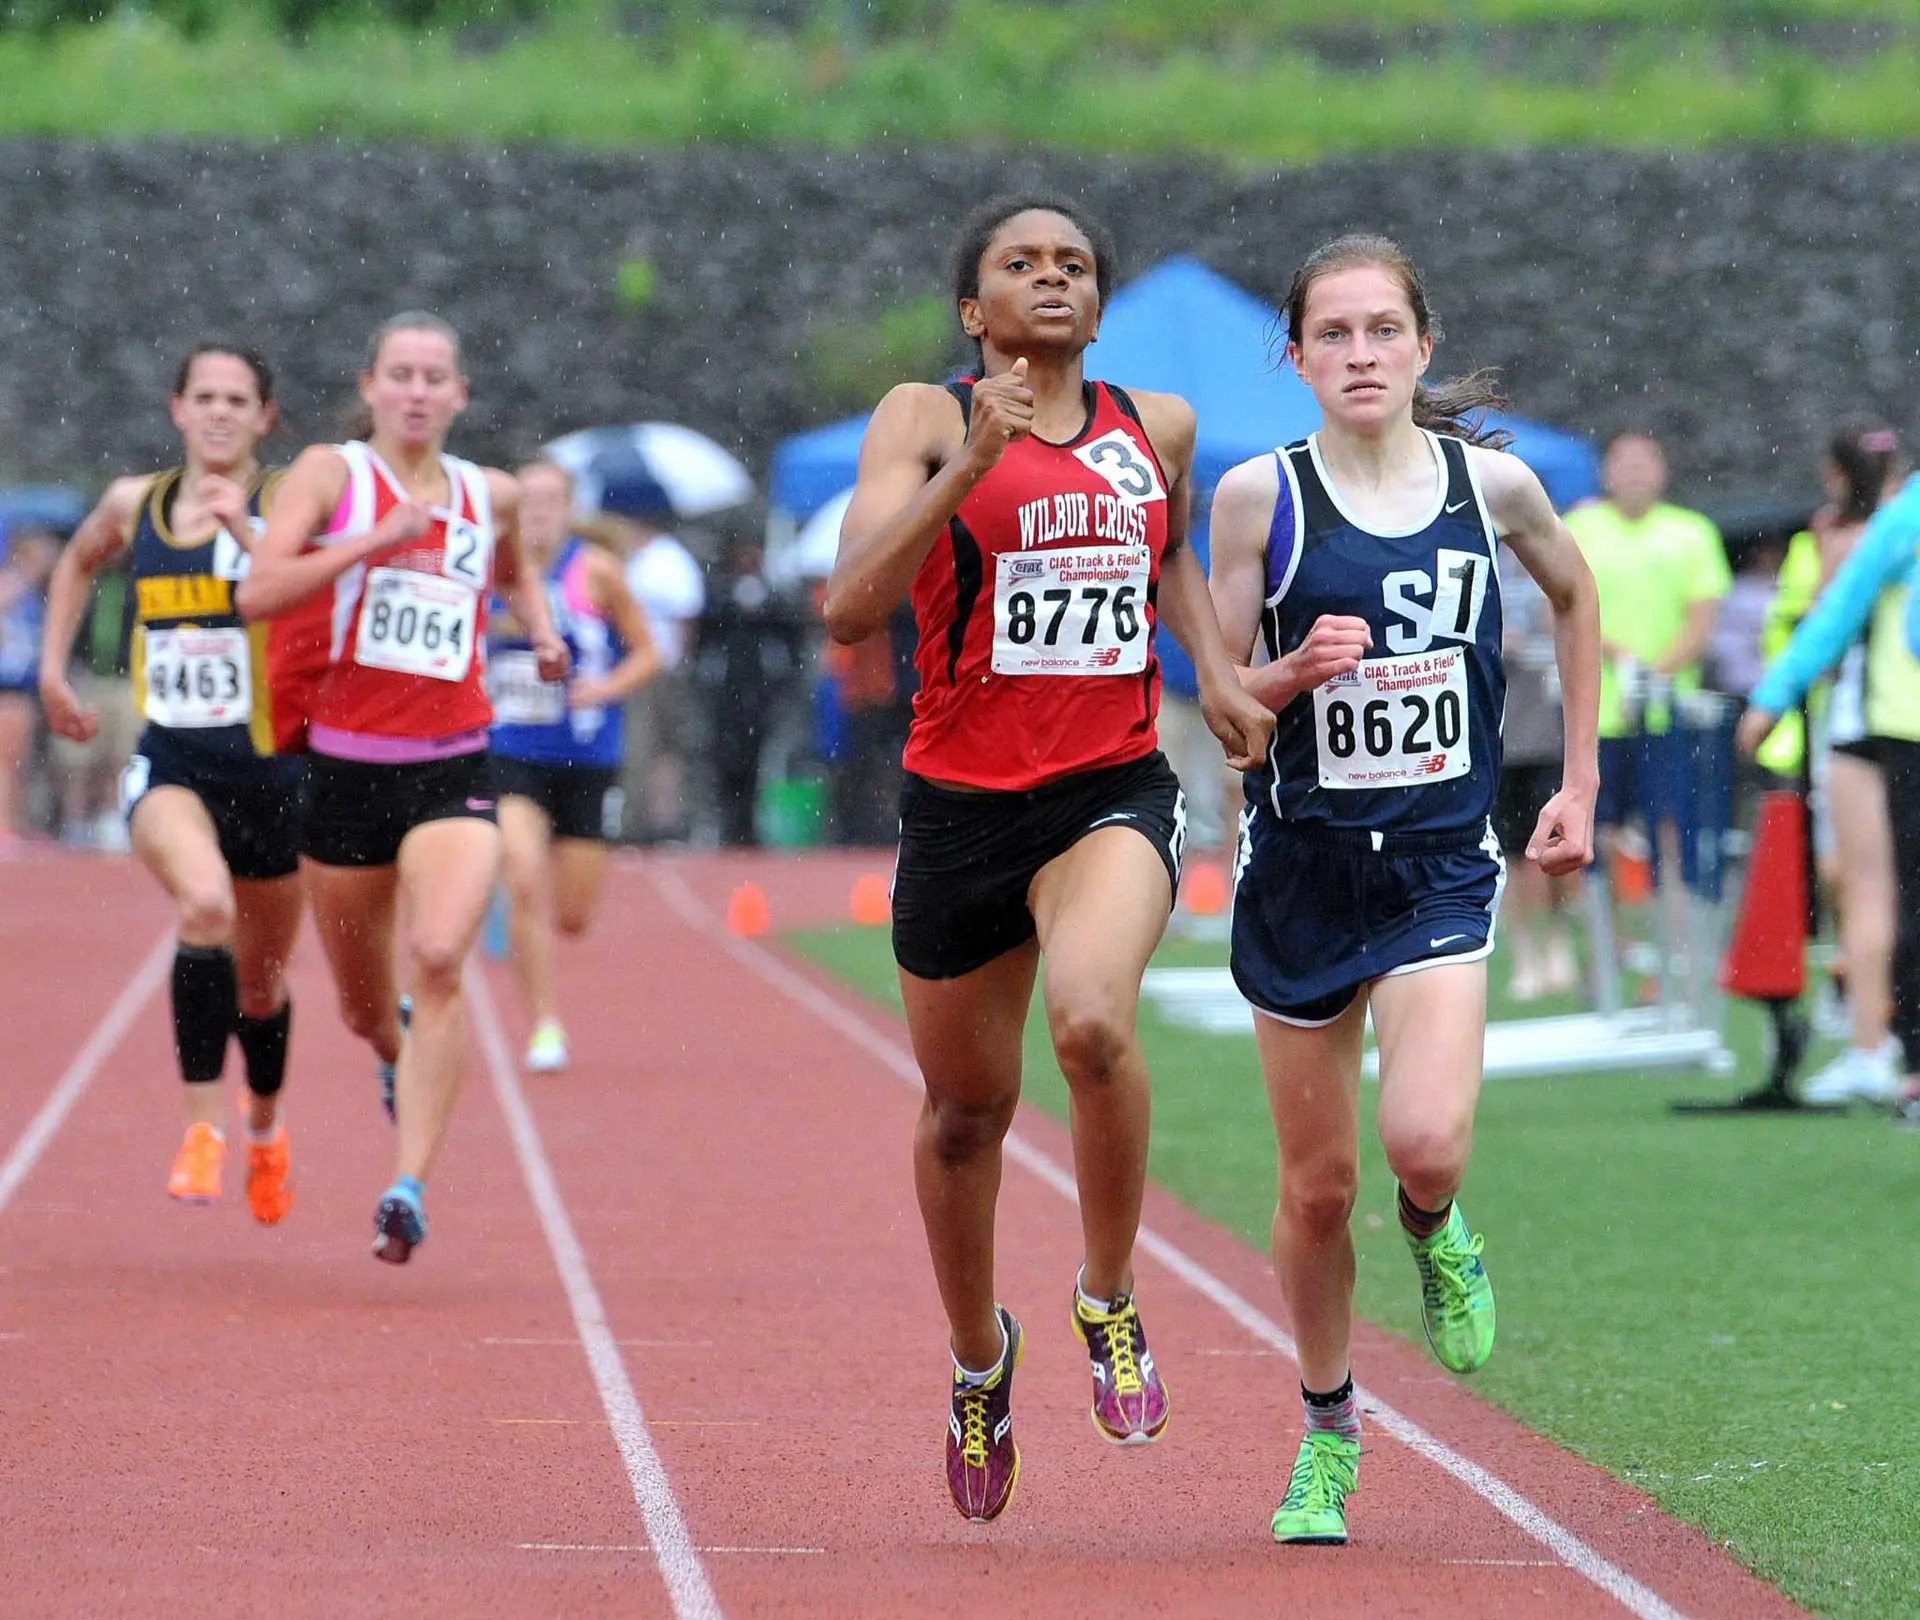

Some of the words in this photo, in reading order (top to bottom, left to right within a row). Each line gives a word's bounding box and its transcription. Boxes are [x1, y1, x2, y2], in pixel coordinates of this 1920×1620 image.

[1090, 441, 1153, 496] 3
[1018, 493, 1089, 551] WILBUR
[1095, 493, 1147, 547] CROSS
[456, 527, 477, 578] 2
[1050, 557, 1073, 569] CIAC
[1076, 555, 1104, 568] Track
[1107, 555, 1115, 567] &
[1117, 553, 1141, 566] Field
[1059, 568, 1129, 583] Championship
[1007, 585, 1140, 646] 8776
[1382, 569, 1434, 655] S
[1448, 558, 1476, 634] 1
[371, 601, 464, 655] 8064
[1021, 659, 1040, 668] new
[1041, 657, 1080, 668] balance
[1364, 666, 1390, 680] CIAC
[1391, 661, 1421, 676] Track
[1424, 660, 1431, 672] &
[1434, 654, 1456, 670] Field
[1376, 671, 1448, 692] Championship
[1326, 689, 1462, 759] 8620
[1348, 772, 1367, 780] new
[1368, 769, 1407, 780] balance
